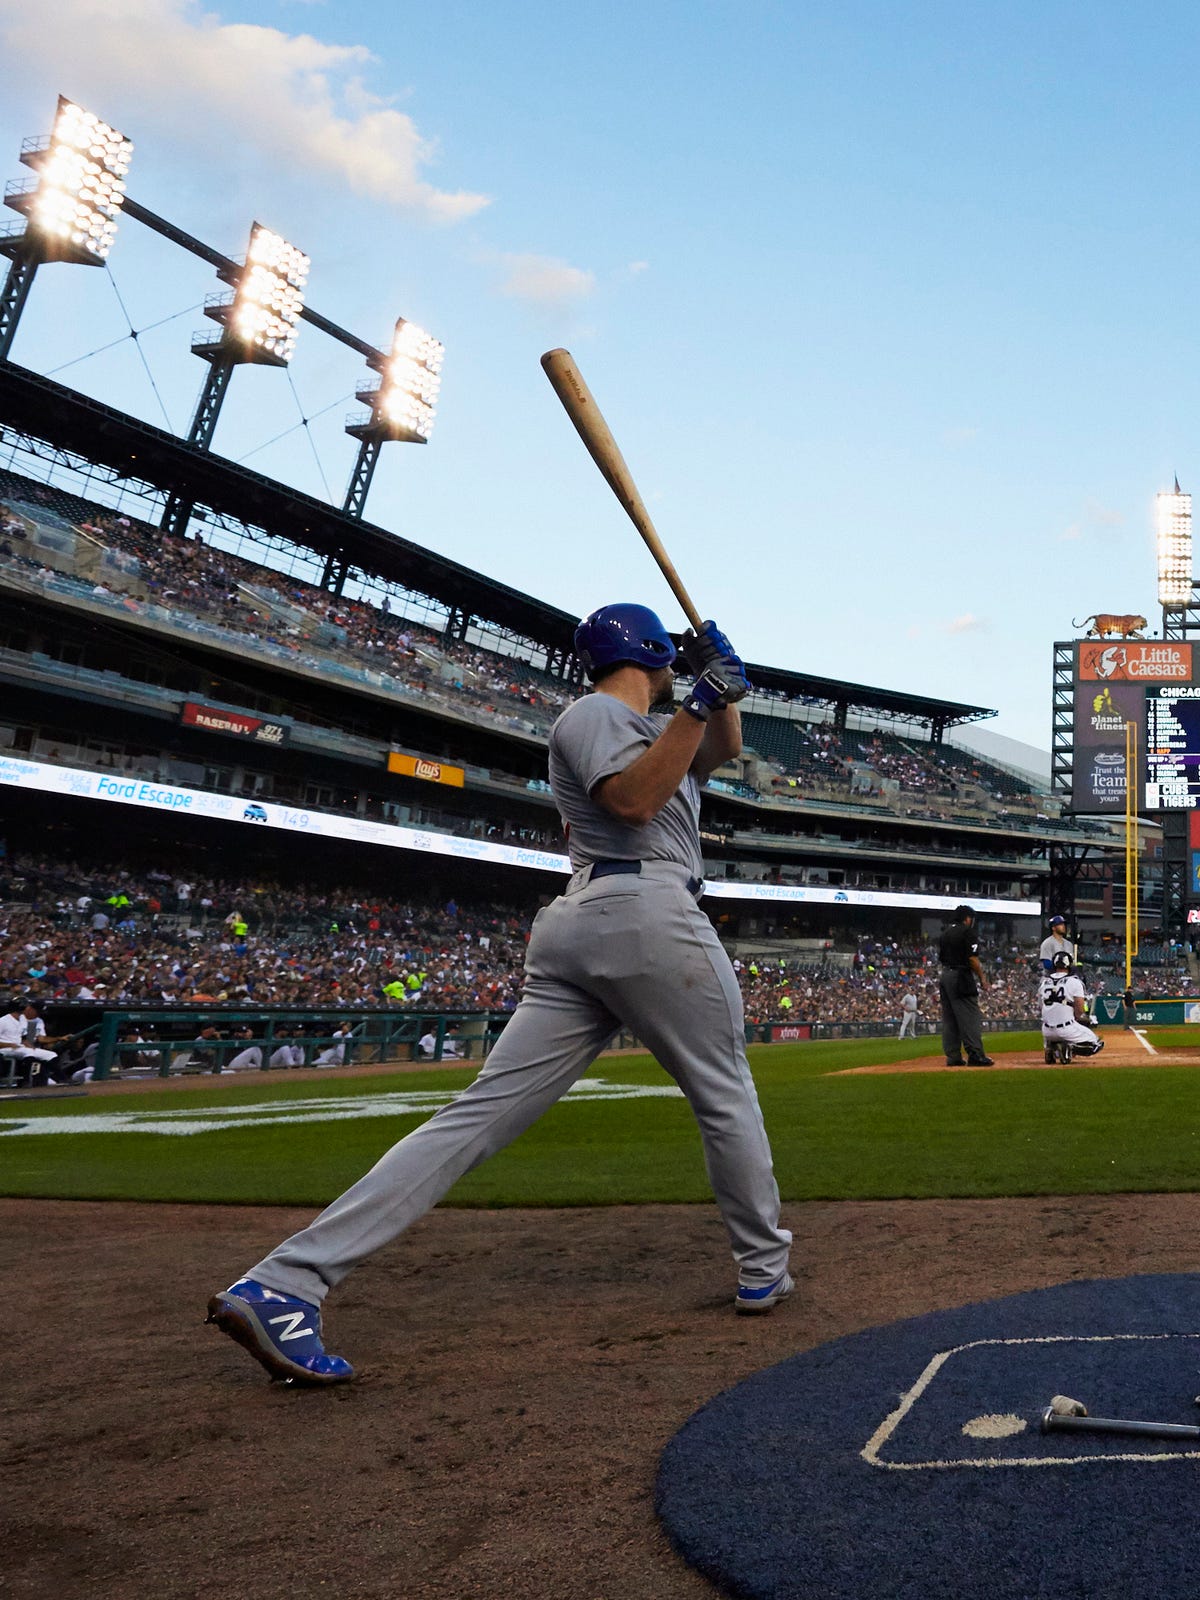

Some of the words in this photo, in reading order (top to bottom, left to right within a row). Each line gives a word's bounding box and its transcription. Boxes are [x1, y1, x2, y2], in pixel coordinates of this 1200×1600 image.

[1140, 648, 1180, 663] Little
[1128, 662, 1187, 676] Caesars
[1091, 715, 1122, 725] planet
[1096, 722, 1128, 730] fitness
[416, 759, 441, 778] Lay's
[1094, 766, 1112, 774] Trust
[1114, 766, 1126, 774] the
[1091, 774, 1128, 786] Team
[97, 777, 138, 798] Ford
[138, 784, 192, 808] Escape
[1163, 784, 1188, 795] CUBS
[1099, 796, 1120, 804] yours
[1163, 796, 1196, 807] TIGERS
[517, 850, 536, 864] Ford
[755, 886, 775, 897] Ford
[776, 888, 806, 898] Escape
[971, 943, 978, 952] 7
